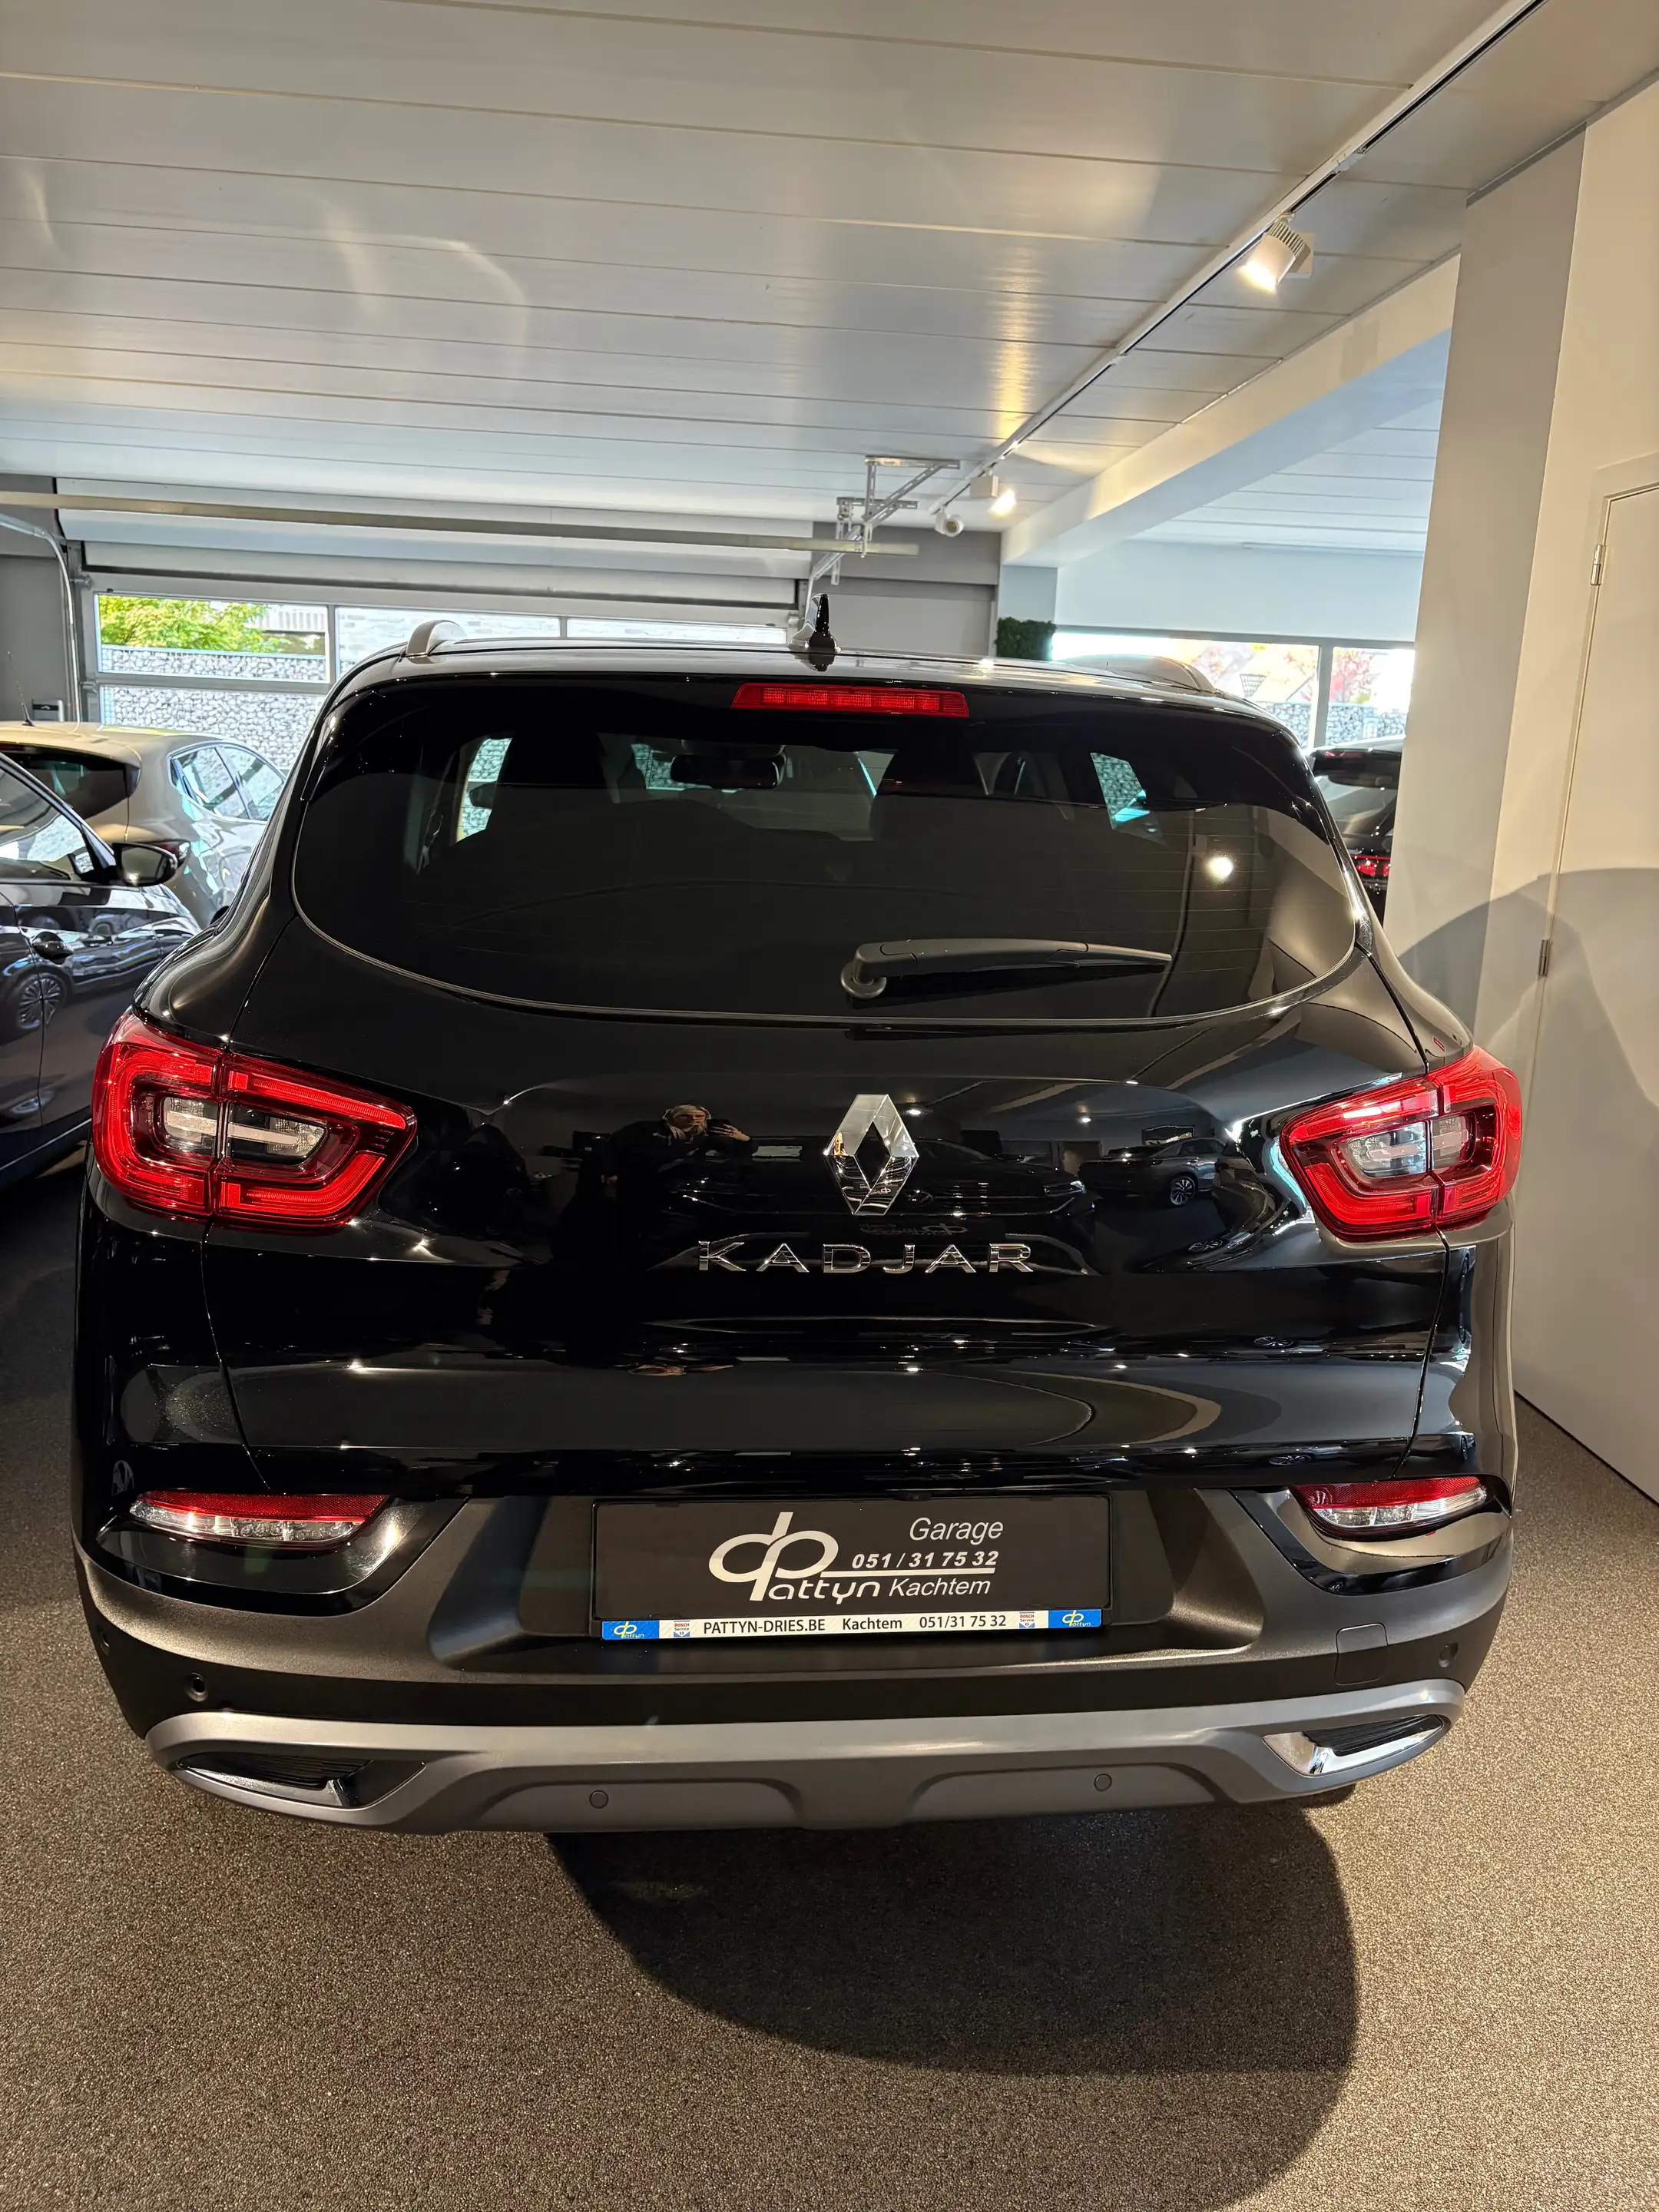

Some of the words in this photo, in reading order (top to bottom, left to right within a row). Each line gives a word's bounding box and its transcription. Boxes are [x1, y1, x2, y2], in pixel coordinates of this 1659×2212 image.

[698, 1240, 1034, 1273] KADJAR
[909, 1517, 1004, 1545] Garage
[852, 1552, 892, 1569] 051
[942, 1551, 969, 1567] 75
[972, 1550, 999, 1566] 32
[888, 1577, 991, 1597] Kachtem
[703, 1618, 826, 1634] PATTYN-DRIES.BE
[842, 1617, 902, 1631] Kachtem
[919, 1615, 965, 1629] 051/31
[970, 1615, 986, 1628] 75
[990, 1614, 1006, 1627] 32
